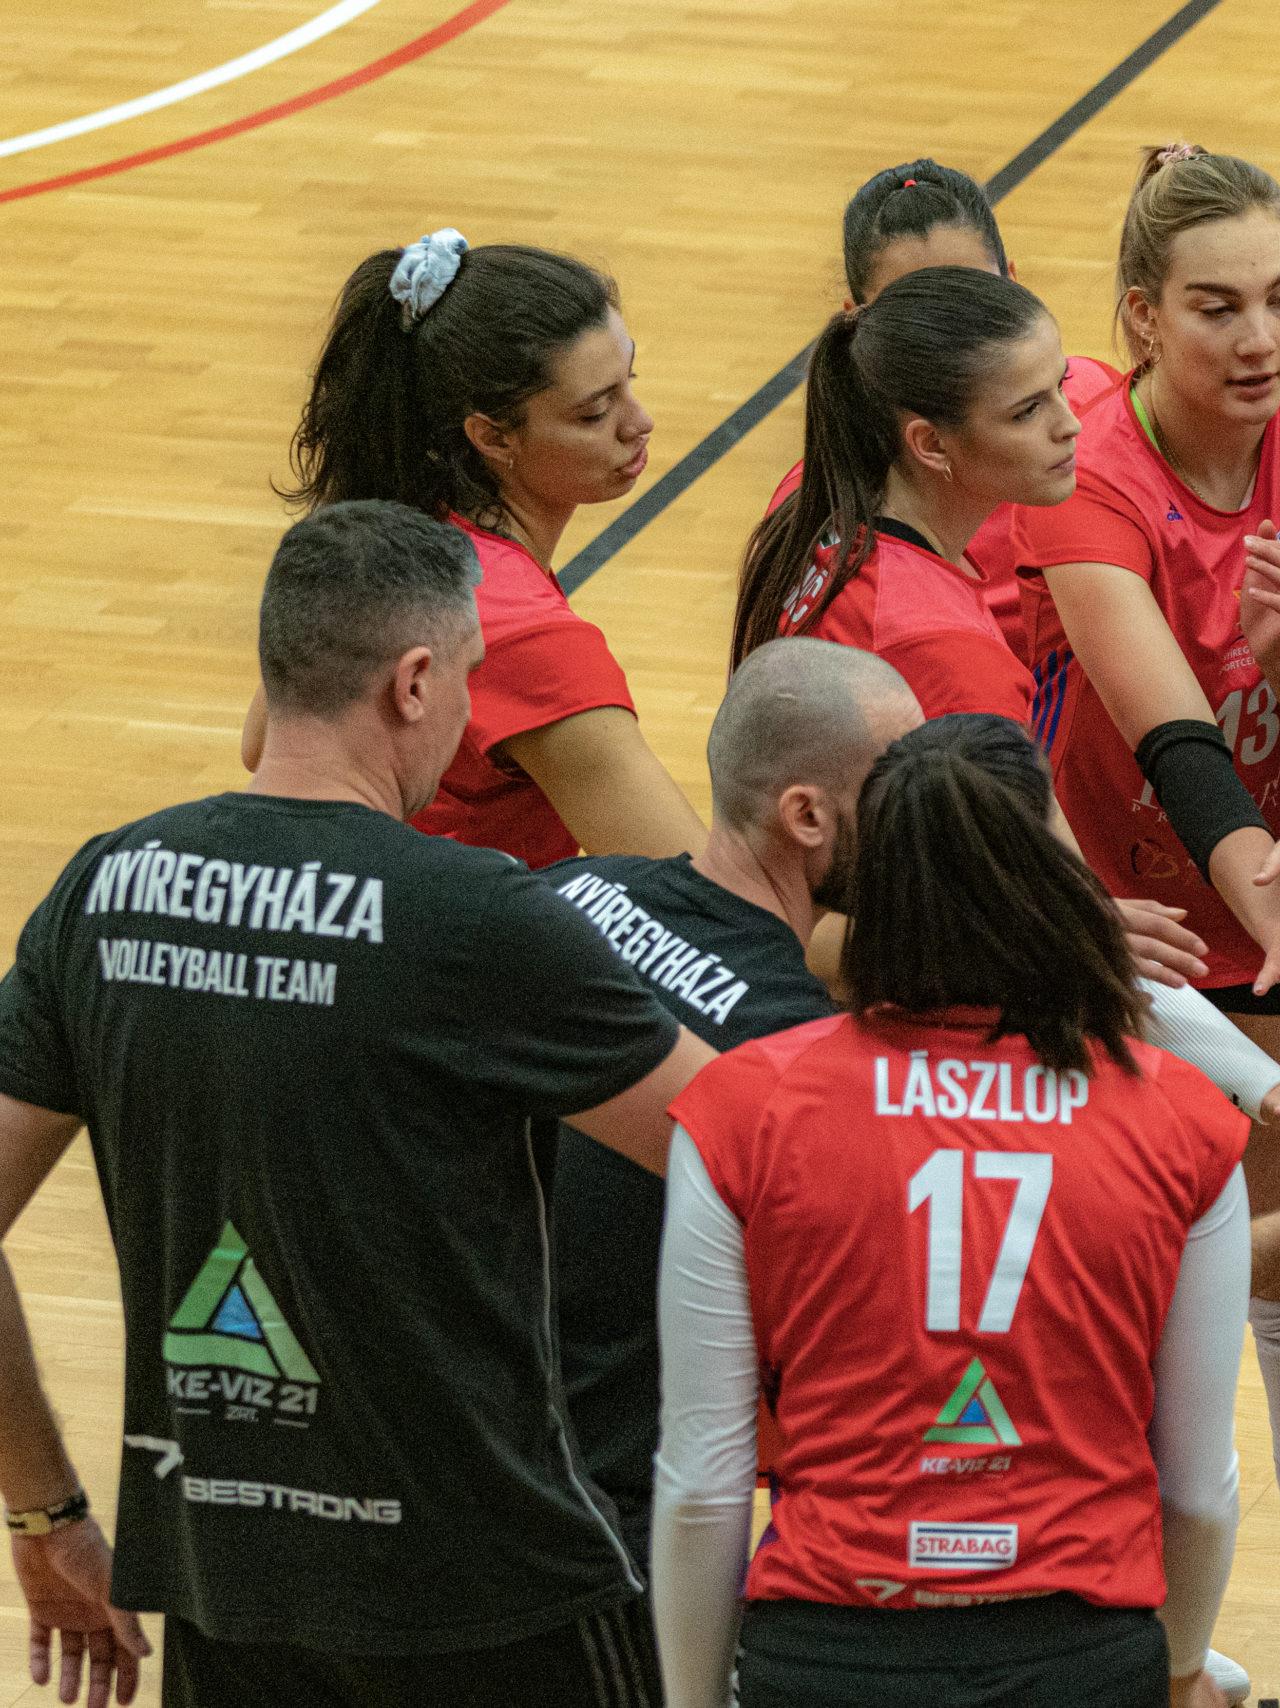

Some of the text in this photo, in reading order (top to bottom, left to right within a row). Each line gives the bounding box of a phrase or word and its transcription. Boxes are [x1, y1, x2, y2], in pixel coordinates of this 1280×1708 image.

[1216, 679, 1280, 766] 13
[85, 839, 384, 944] NYÍREGYHÁZA
[98, 937, 338, 1006] VOLLEYBALL TEAM
[556, 872, 750, 1026] NYÍREGYHÁZA
[907, 1148, 1053, 1333] 17
[276, 1384, 319, 1415] 21
[181, 1475, 403, 1525] BESTRONG
[915, 1535, 1012, 1556] STRABAG
